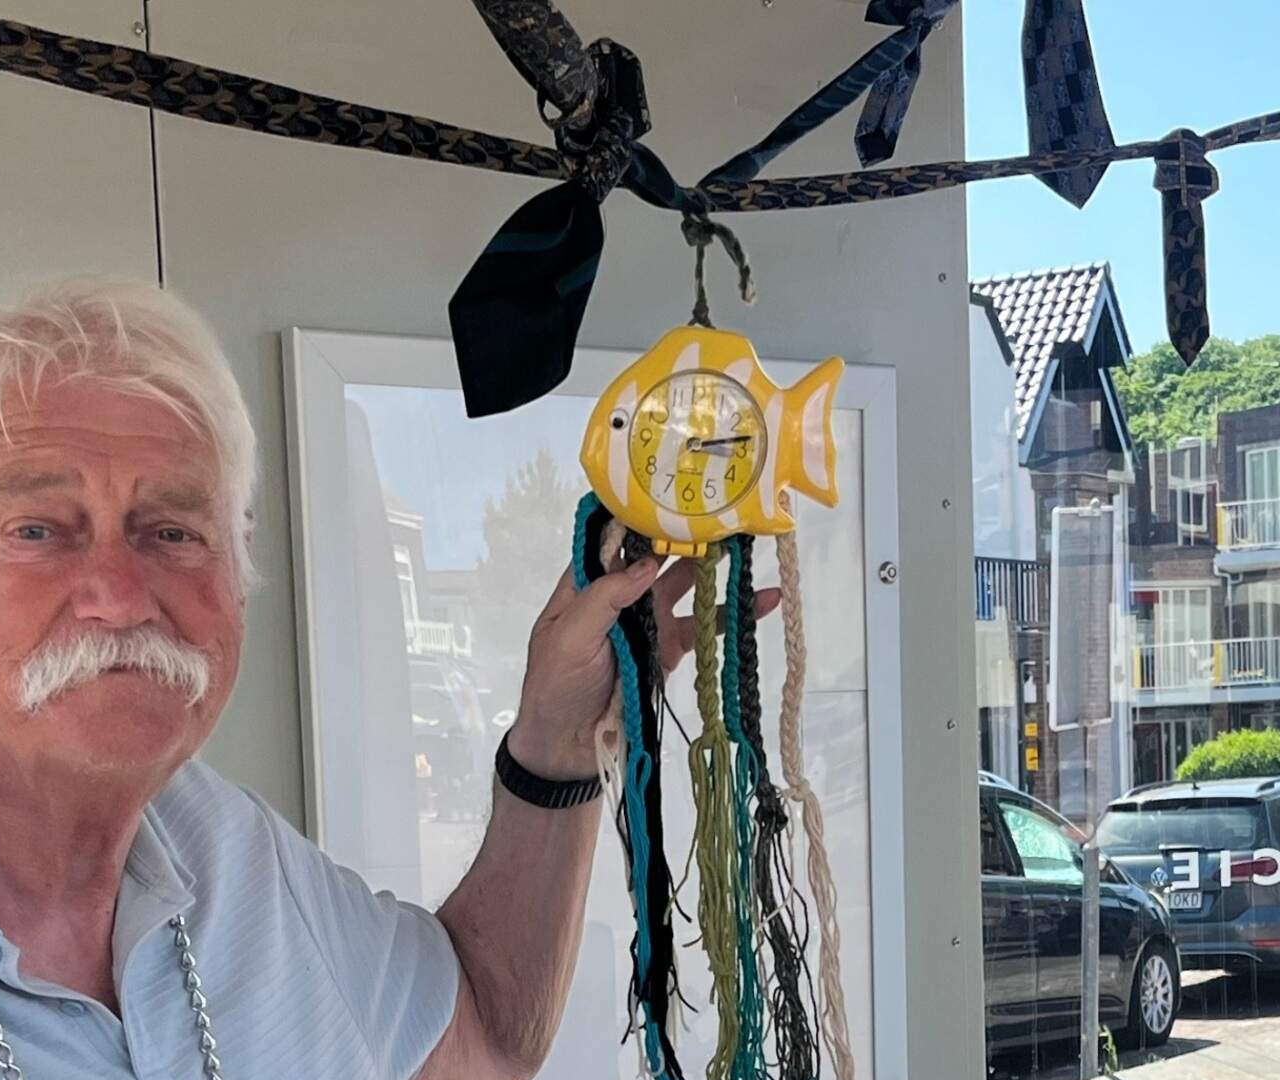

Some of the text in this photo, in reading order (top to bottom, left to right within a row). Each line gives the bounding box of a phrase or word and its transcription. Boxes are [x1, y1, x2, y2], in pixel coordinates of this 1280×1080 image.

[640, 428, 652, 448] 9
[645, 456, 657, 476] 8
[724, 464, 736, 483] 4
[663, 474, 676, 494] 7
[682, 482, 696, 503] 6
[703, 479, 717, 499] 5
